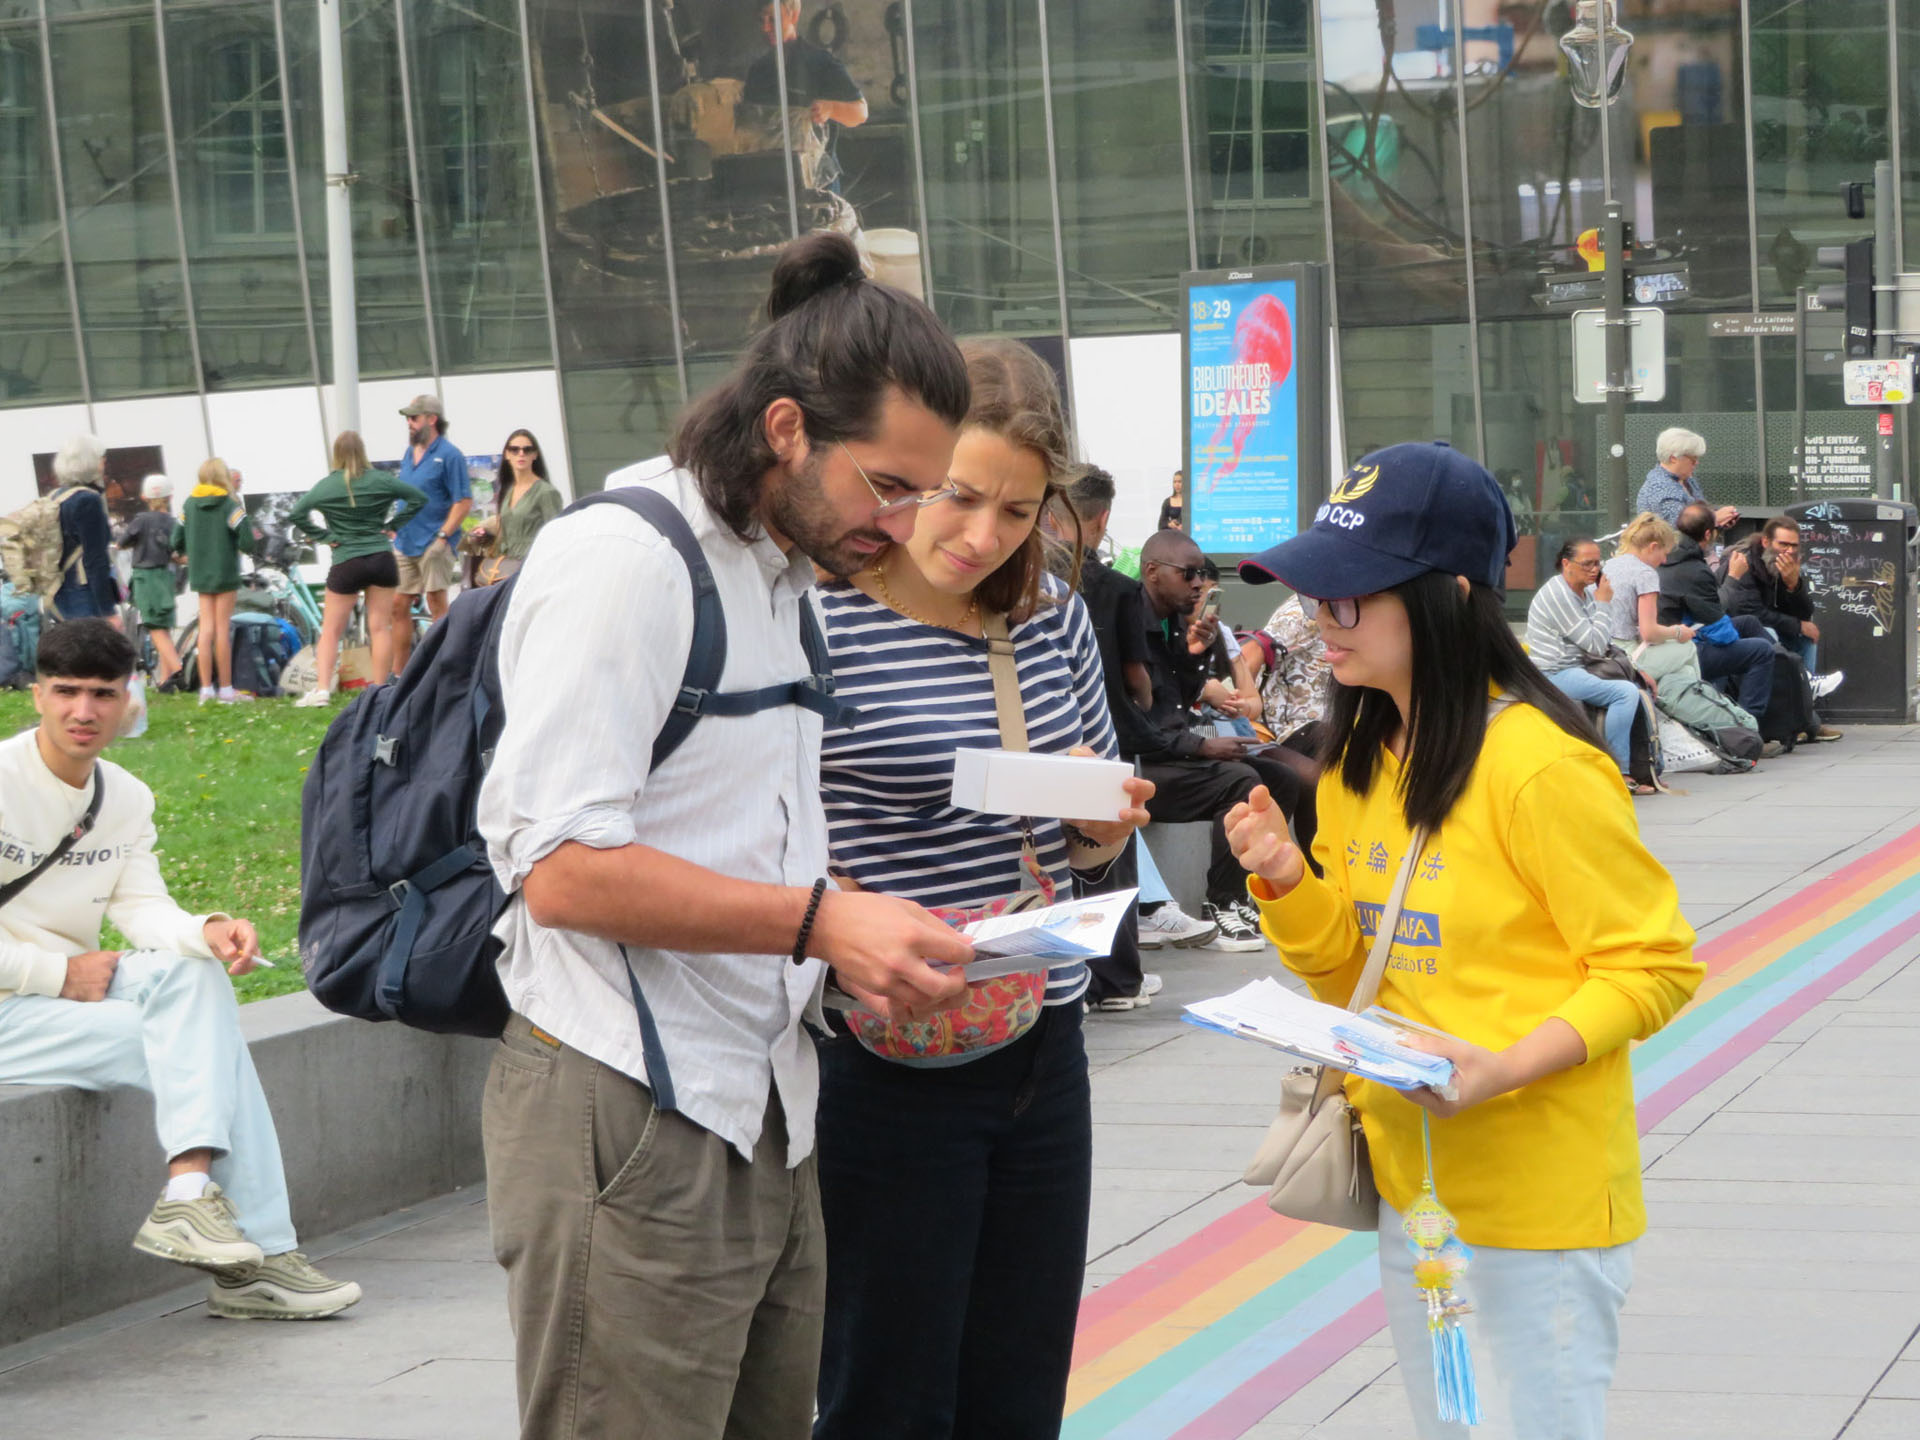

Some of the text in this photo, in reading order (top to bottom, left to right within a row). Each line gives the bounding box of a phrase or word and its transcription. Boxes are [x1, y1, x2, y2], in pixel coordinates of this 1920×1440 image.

[1213, 300, 1231, 318] 29
[1834, 446, 1867, 454] ESPACE
[1805, 456, 1859, 464] ON- FUMEUR
[1789, 465, 1817, 474] MCI
[1824, 475, 1871, 484] CIGARETTE
[1329, 506, 1365, 530] CCP
[0, 841, 25, 864] VER
[1347, 839, 1445, 881] 輪法
[1396, 914, 1434, 941] AFA
